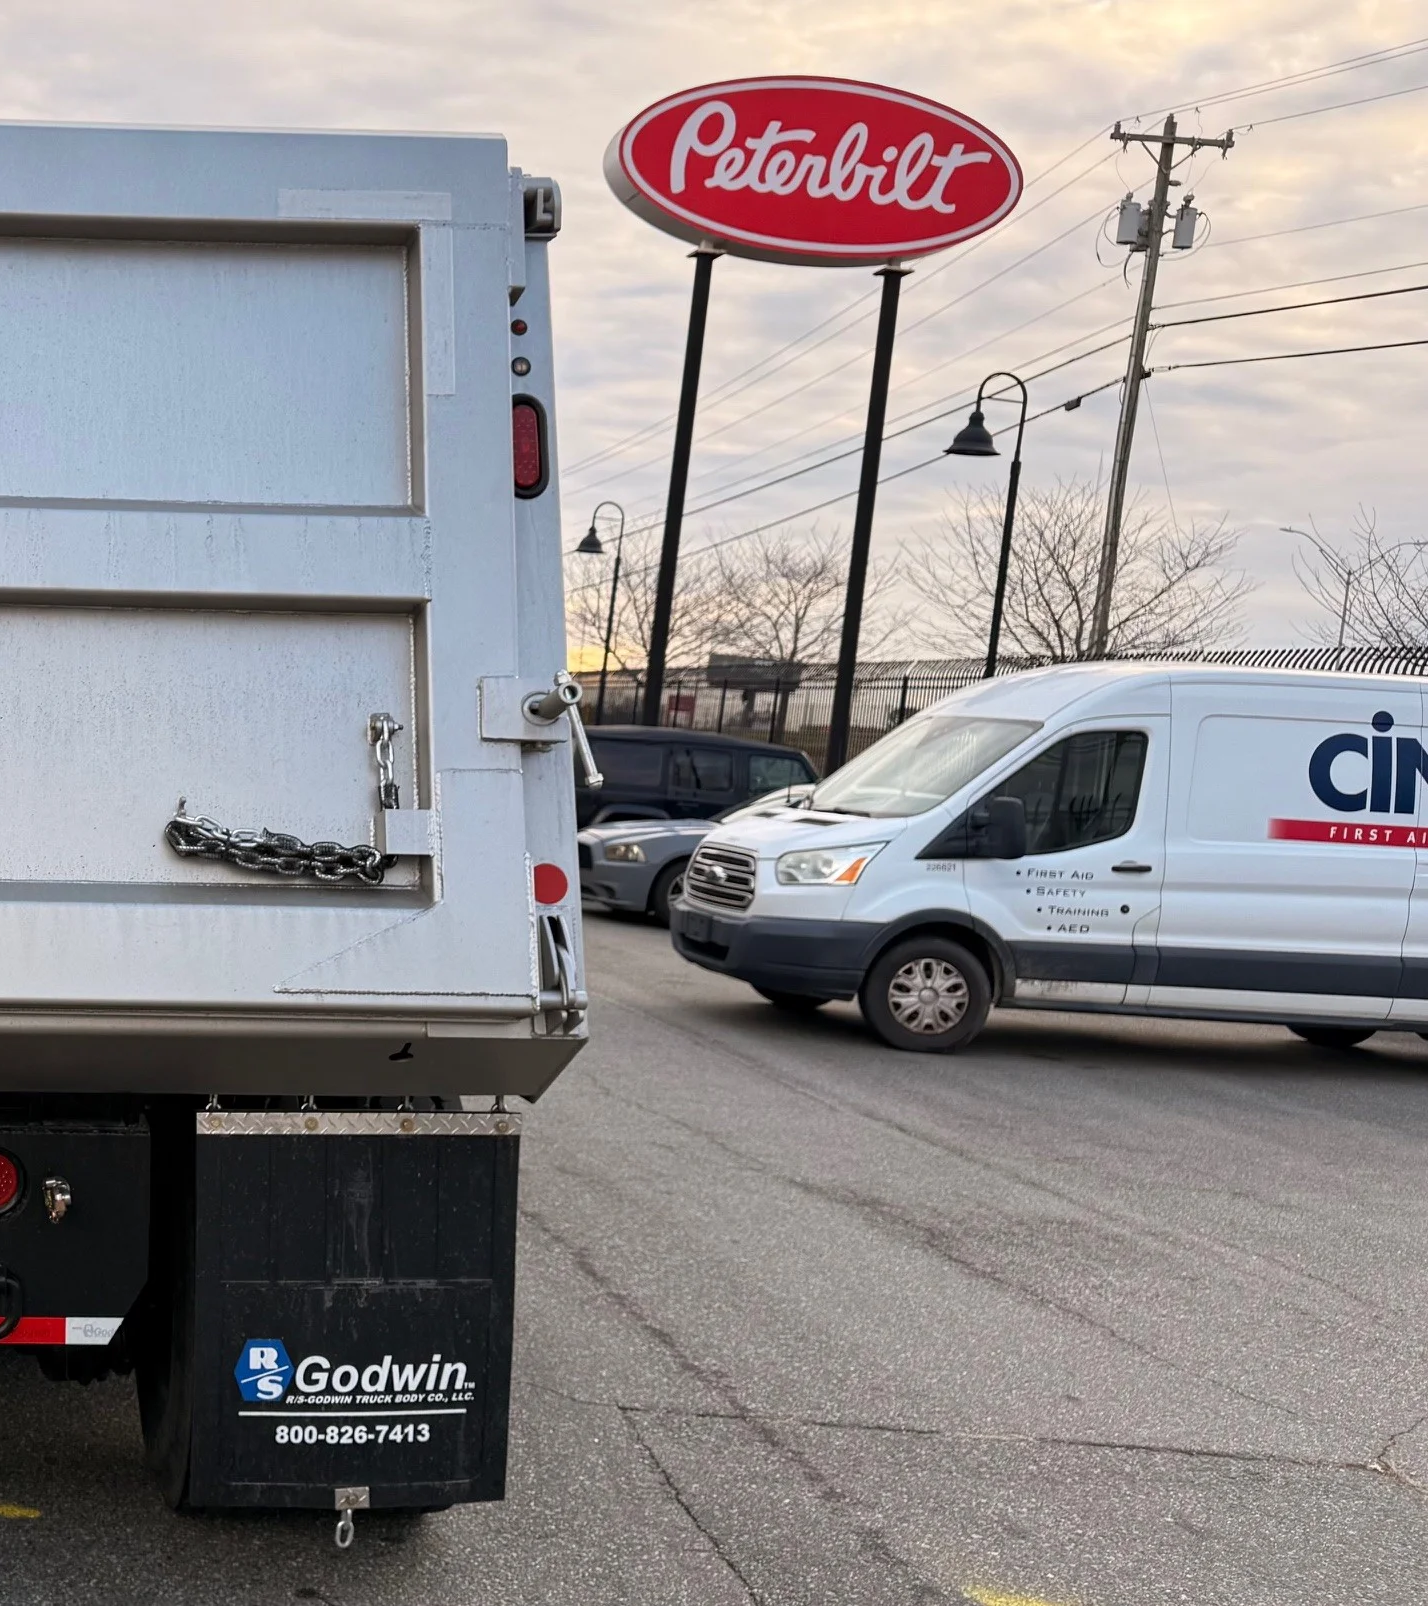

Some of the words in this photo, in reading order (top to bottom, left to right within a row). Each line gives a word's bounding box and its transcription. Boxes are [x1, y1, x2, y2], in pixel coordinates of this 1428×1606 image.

[669, 100, 992, 214] Peterbilt
[1329, 826, 1393, 842] FIRST
[1027, 868, 1065, 879] FIRST
[1071, 870, 1094, 880] AID
[1036, 886, 1086, 898] SAFETY
[1057, 923, 1090, 934] AED
[295, 1354, 468, 1393] Godwin
[285, 1395, 352, 1404] R/S-GODWIN
[355, 1394, 393, 1404] TRUCK
[396, 1393, 426, 1403] BODY
[451, 1392, 475, 1401] LLC.
[275, 1423, 431, 1444] 800-826-7413
